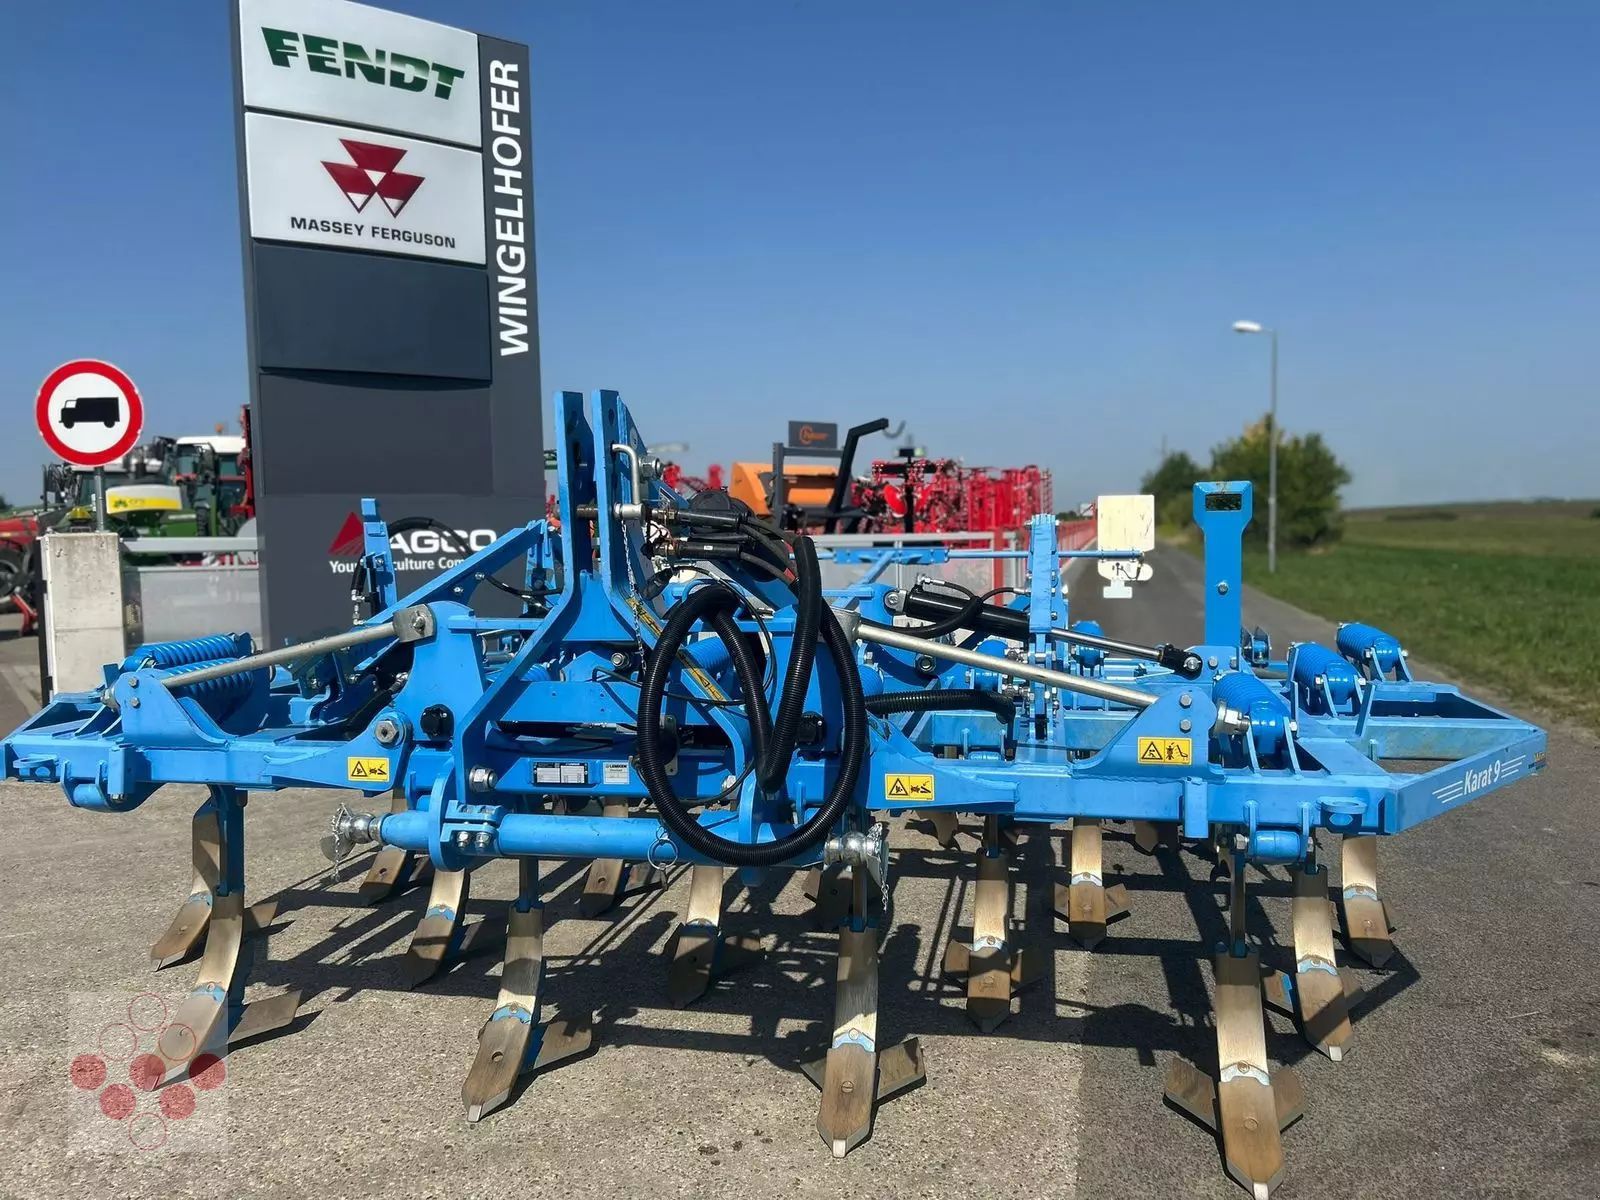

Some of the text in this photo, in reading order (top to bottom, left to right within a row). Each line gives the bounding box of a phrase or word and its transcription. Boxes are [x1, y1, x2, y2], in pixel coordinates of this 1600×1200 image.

[261, 27, 465, 100] FENDT
[290, 216, 456, 249] MASSEY FERGUSON
[489, 59, 530, 356] WINGELHOFER
[1463, 764, 1493, 796] Karat
[1493, 760, 1501, 783] 9
